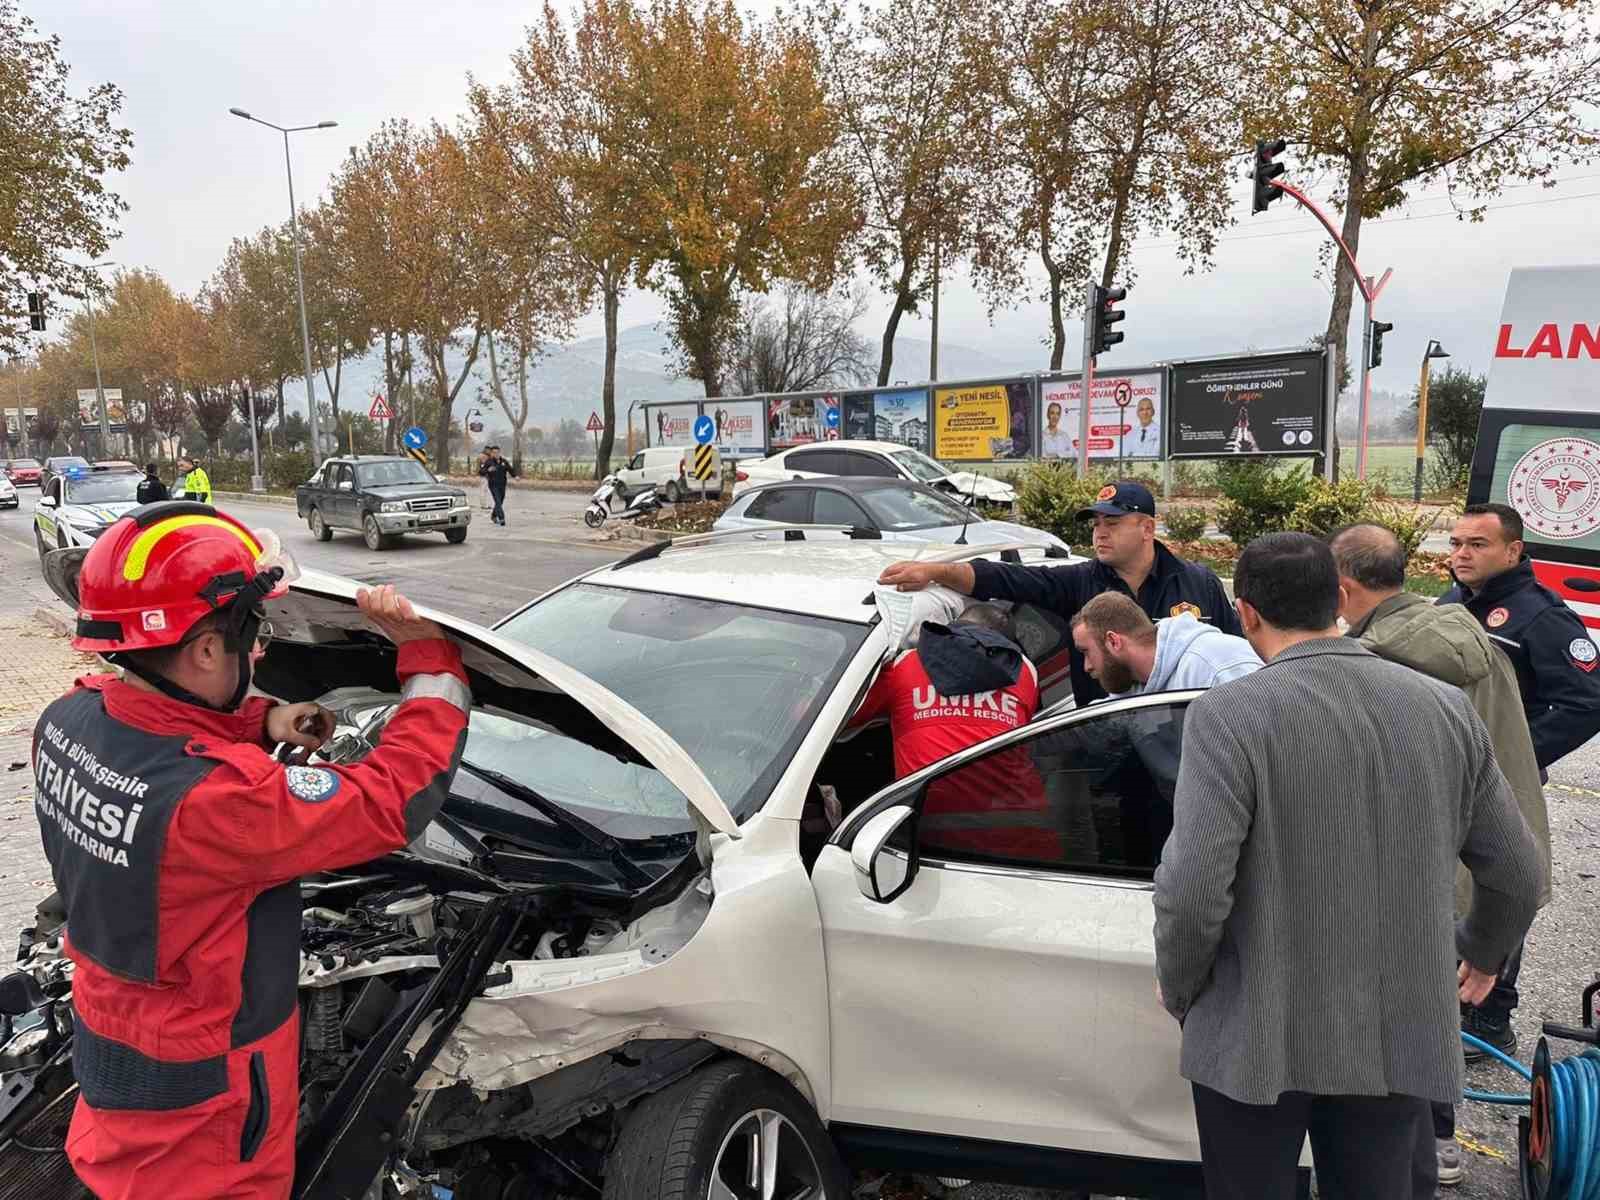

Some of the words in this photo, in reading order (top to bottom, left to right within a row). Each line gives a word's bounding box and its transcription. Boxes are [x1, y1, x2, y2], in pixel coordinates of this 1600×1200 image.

[1495, 323, 1600, 359] LAN
[959, 389, 978, 402] YENİ
[979, 388, 1002, 401] NESİL
[1261, 378, 1284, 389] GÜNÜ
[912, 684, 1019, 718] UMKE
[913, 706, 970, 721] MEDICAL
[67, 742, 150, 799] BÜYÜKŞEHİR
[35, 738, 144, 845] İTFAİYESİ
